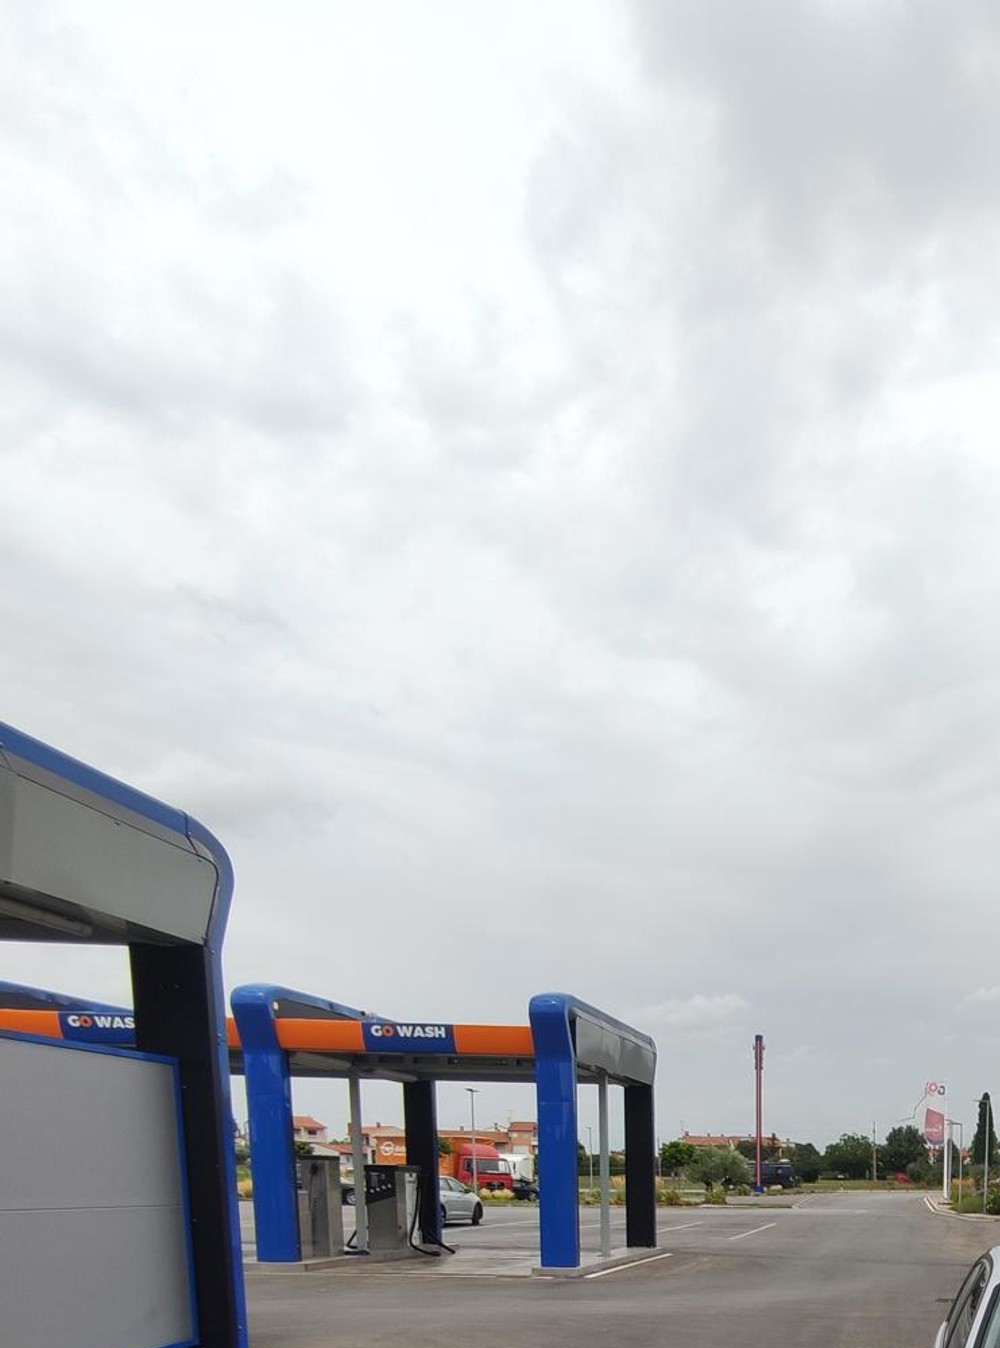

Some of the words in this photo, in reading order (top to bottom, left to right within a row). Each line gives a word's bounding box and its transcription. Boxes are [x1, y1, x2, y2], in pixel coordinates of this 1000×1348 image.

[67, 1015, 92, 1028] GO
[93, 1015, 136, 1029] WAS
[370, 1024, 394, 1037] GO
[396, 1025, 446, 1038] WASH
